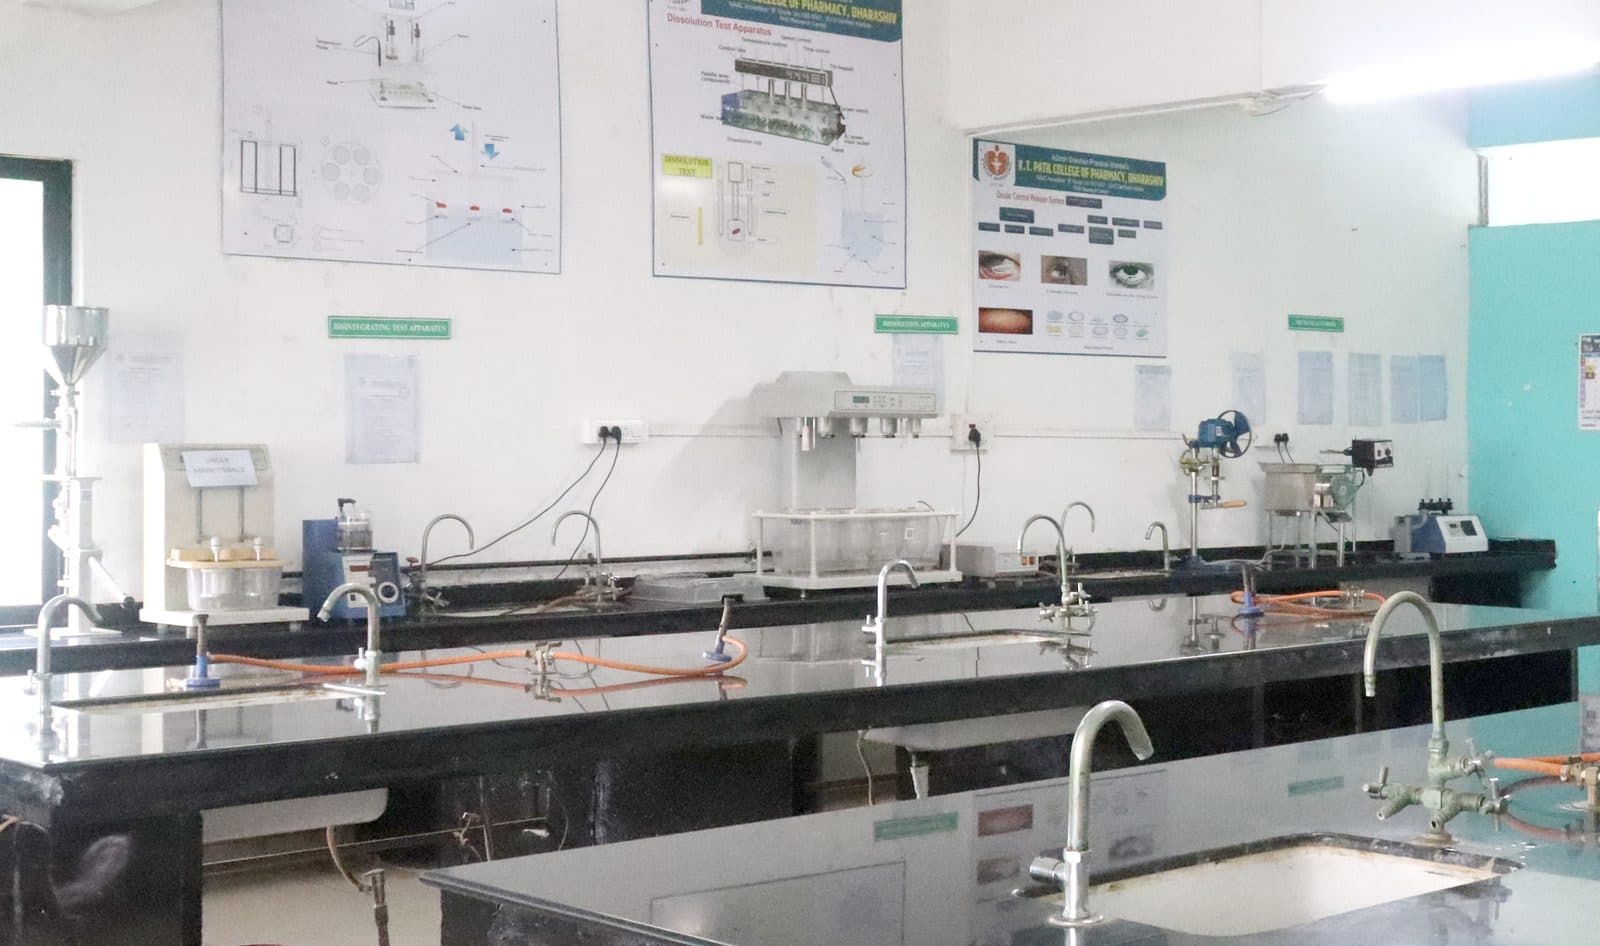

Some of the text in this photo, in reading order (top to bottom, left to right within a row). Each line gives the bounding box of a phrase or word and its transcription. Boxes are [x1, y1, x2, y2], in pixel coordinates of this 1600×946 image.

[667, 13, 772, 36] Dissolution Test Apparatus
[1053, 163, 1080, 177] COLLEGE
